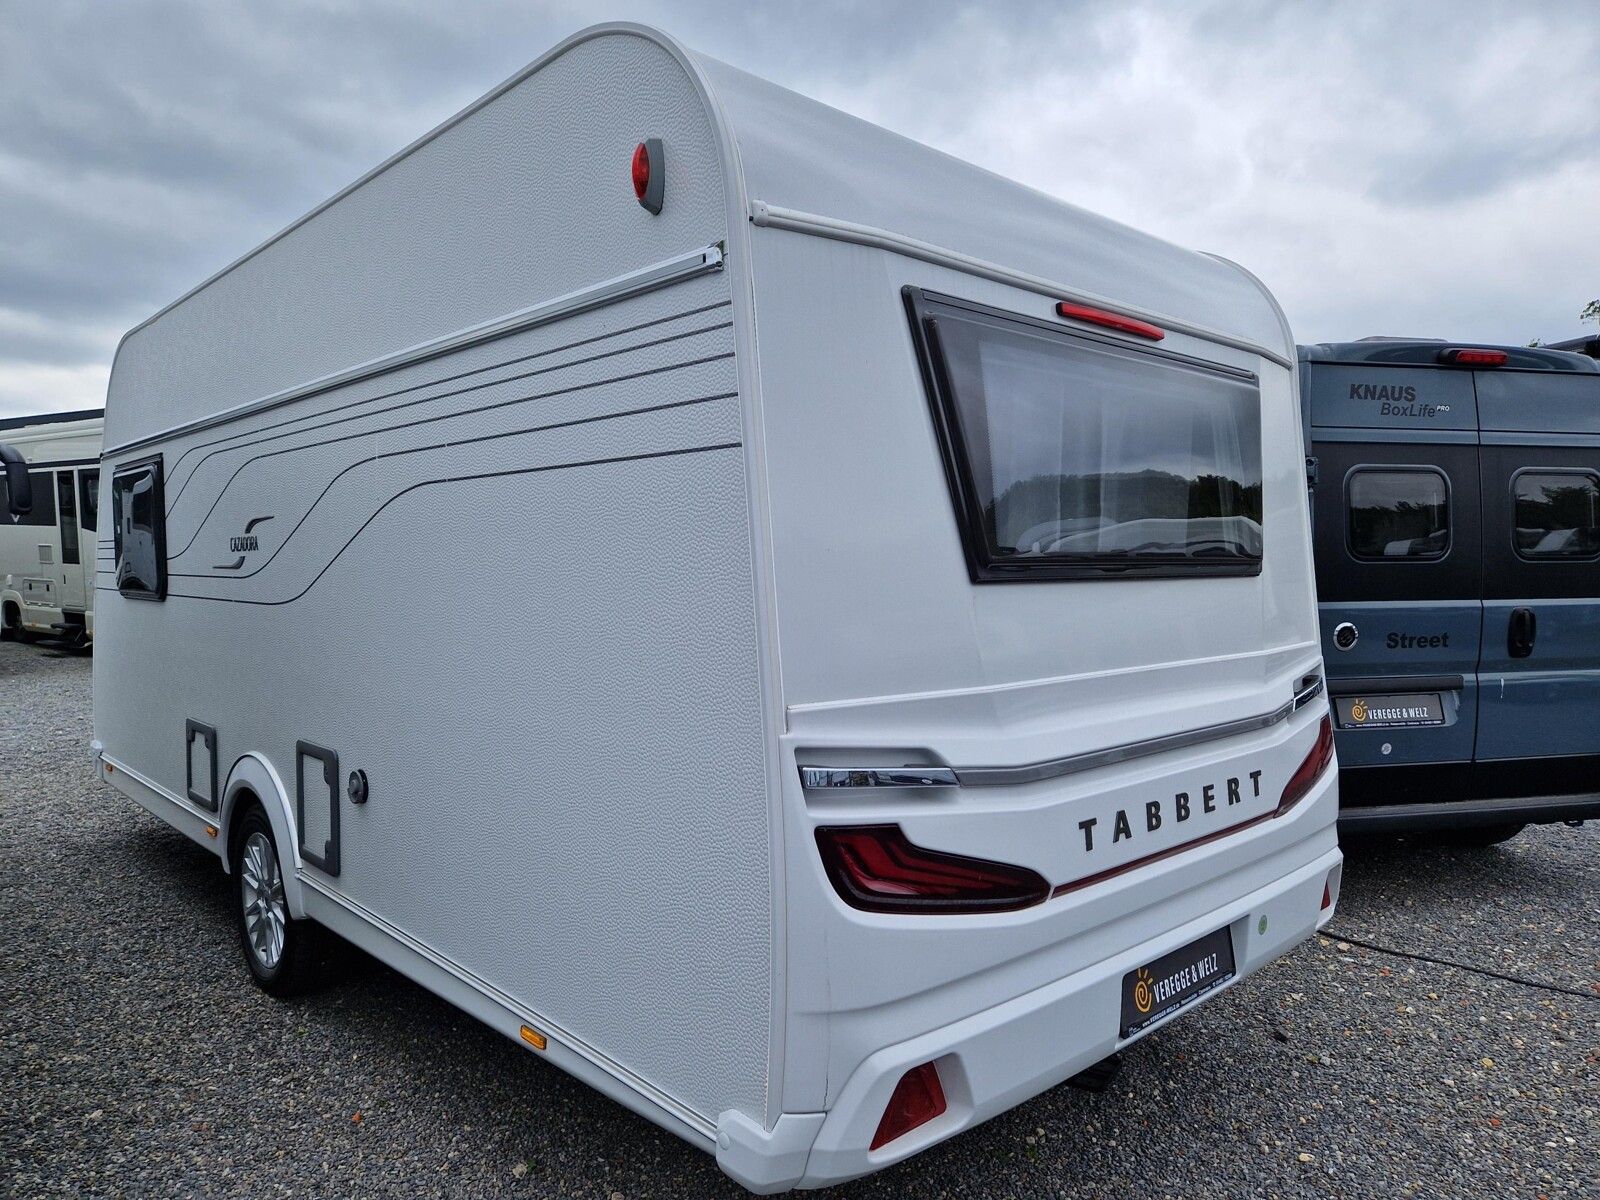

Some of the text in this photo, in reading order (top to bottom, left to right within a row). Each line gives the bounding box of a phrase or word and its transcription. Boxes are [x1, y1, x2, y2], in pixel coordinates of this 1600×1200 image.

[1350, 384, 1416, 402] KNAUS
[1380, 402, 1436, 417] BoxLife
[230, 536, 259, 552] CAZADORA
[1386, 632, 1450, 649] Street
[1368, 707, 1428, 720] VEREGGE & WELZ
[1078, 769, 1262, 852] TABBERT
[1153, 967, 1191, 1003] VEREGGE
[1191, 964, 1198, 983] &
[1197, 952, 1218, 979] WELZ
